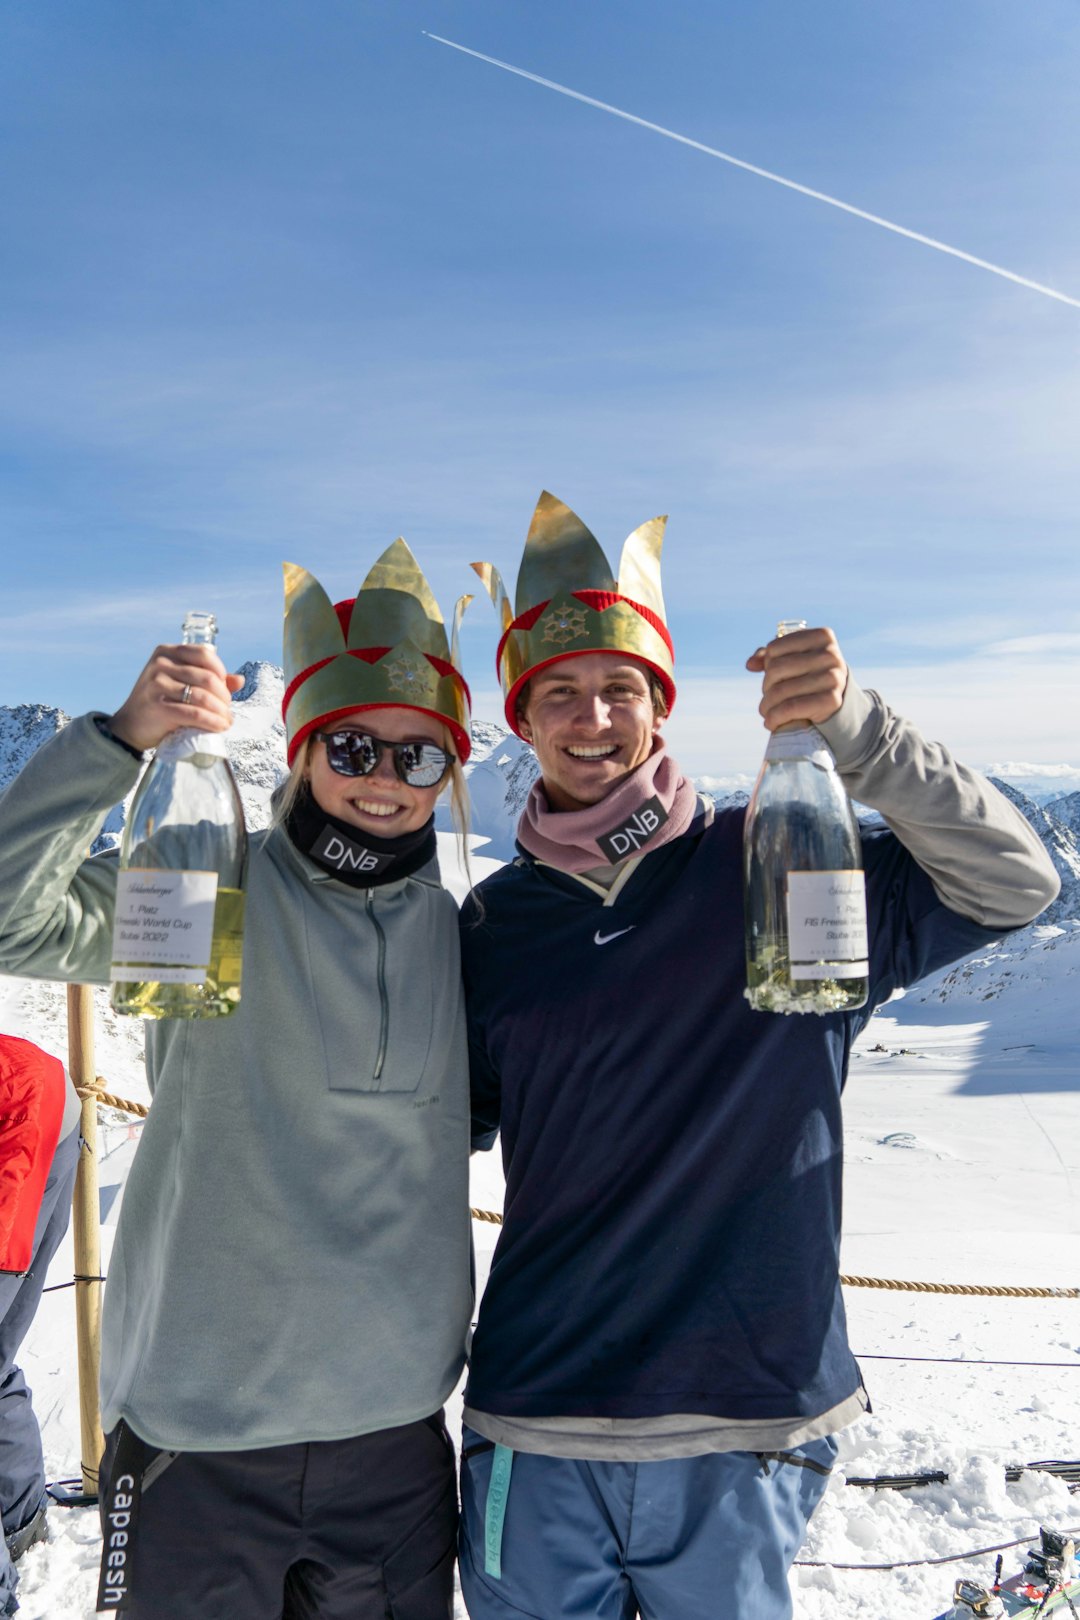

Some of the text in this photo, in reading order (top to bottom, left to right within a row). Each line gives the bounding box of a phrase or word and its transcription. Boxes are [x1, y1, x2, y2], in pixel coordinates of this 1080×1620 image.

[609, 809, 660, 855] DNB
[323, 837, 379, 871] DNB
[142, 931, 169, 943] 2022
[143, 918, 171, 928] World
[173, 919, 192, 931] Cup
[104, 1473, 135, 1603] capeesh
